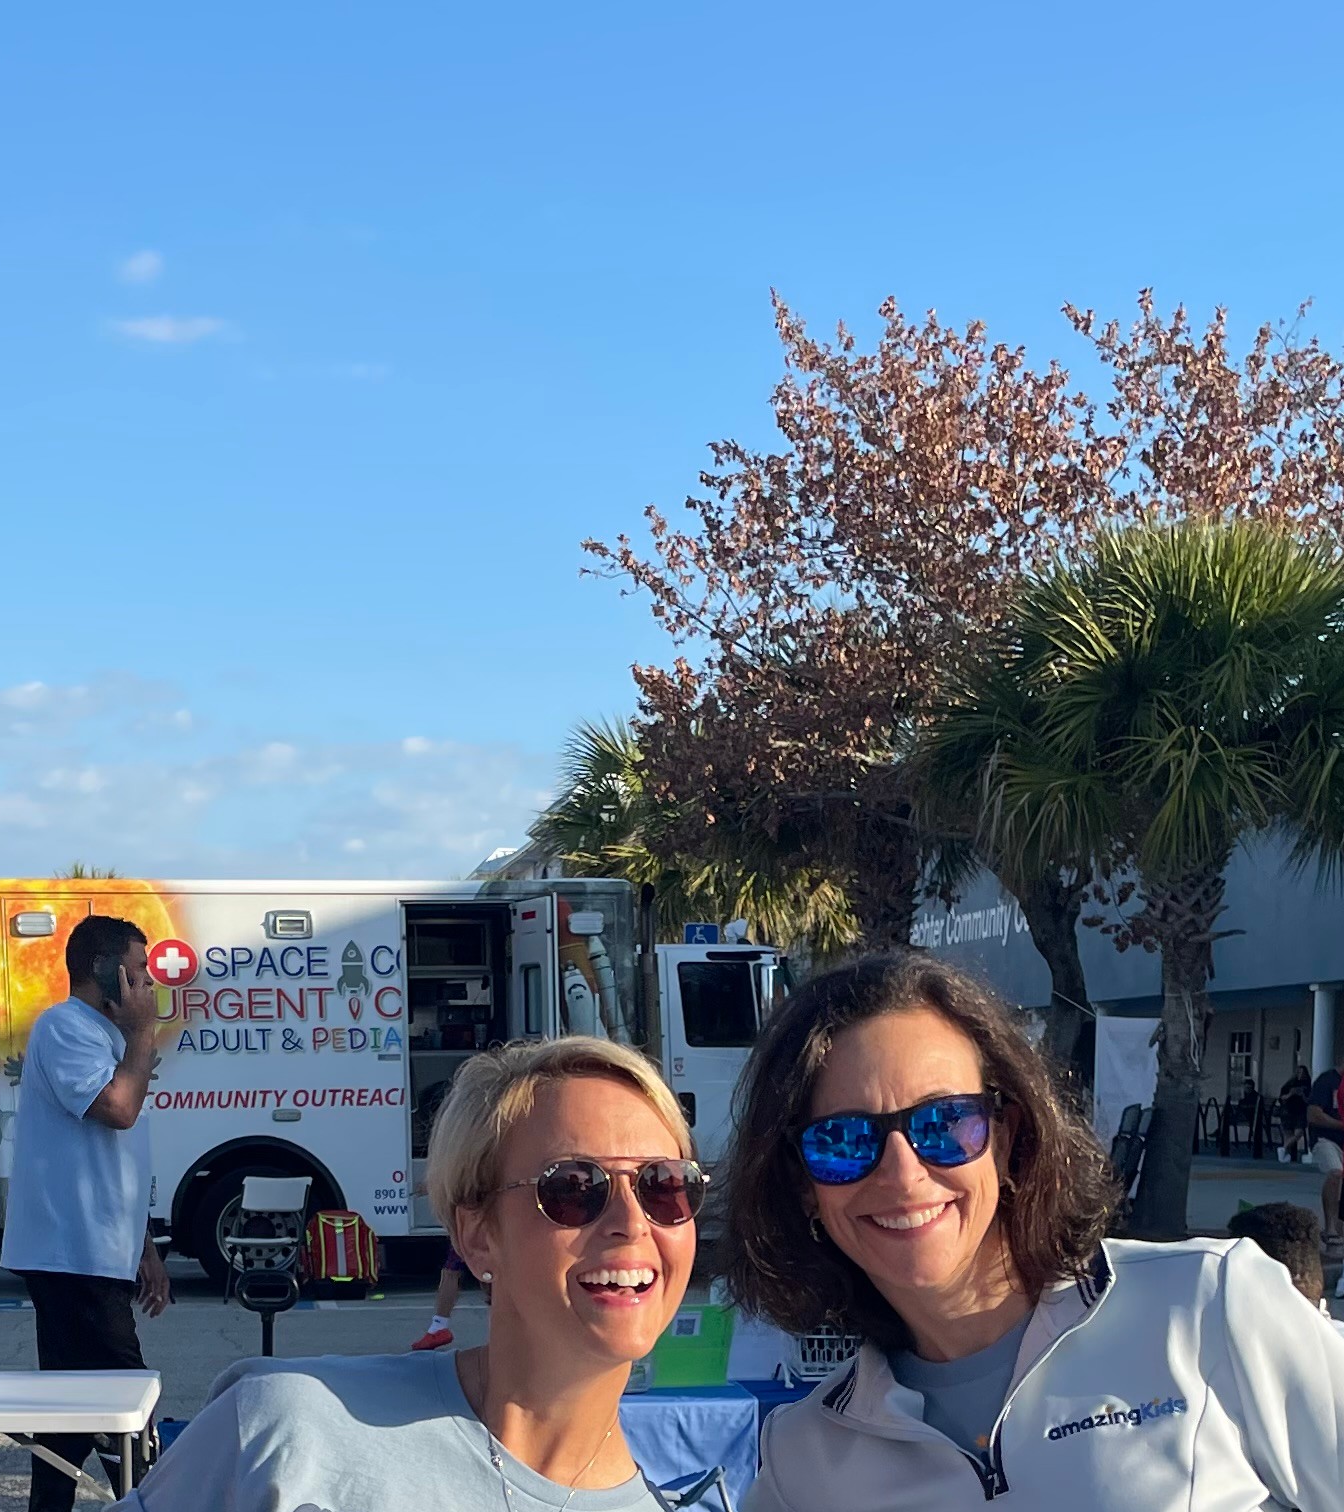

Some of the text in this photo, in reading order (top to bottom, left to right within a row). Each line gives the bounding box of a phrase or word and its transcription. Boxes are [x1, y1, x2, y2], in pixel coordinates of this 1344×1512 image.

[206, 946, 328, 978] SPACE
[156, 987, 335, 1021] URGENT
[177, 1027, 403, 1052] ADULT & PEDIA
[374, 1189, 396, 1200] 890
[1048, 1396, 1188, 1441] amazingKids
